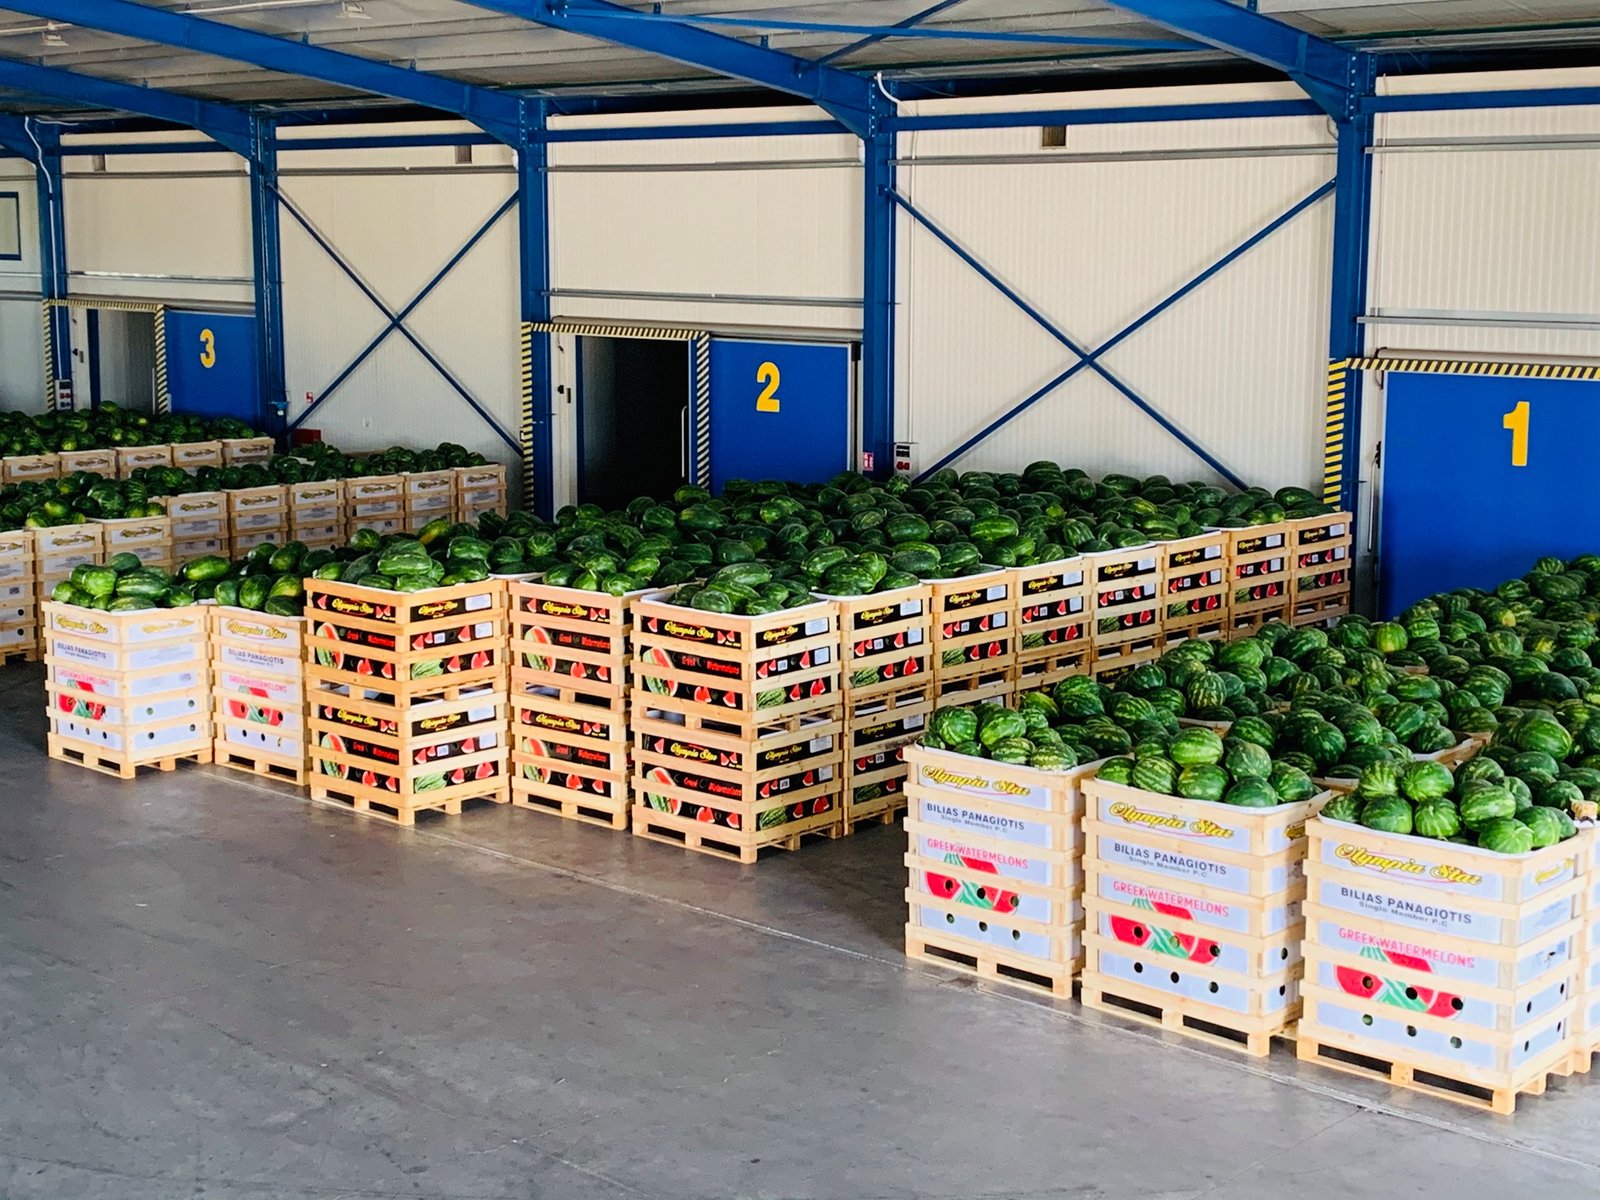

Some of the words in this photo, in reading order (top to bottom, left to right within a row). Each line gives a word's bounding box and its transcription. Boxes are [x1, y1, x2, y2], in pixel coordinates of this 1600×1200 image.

[200, 328, 216, 369] 3
[756, 361, 780, 413] 2
[1503, 401, 1530, 467] 1
[992, 780, 1031, 797] Star
[927, 803, 958, 817] BILIAS
[962, 810, 1025, 831] PANAGIOTIS
[1189, 818, 1234, 839] Star
[1114, 843, 1150, 859] BILIAS
[1154, 851, 1227, 875] PANAGIOTIS
[1430, 864, 1483, 886] Star
[1341, 887, 1382, 905] BILIAS
[1388, 898, 1472, 924] PANAGIOTIS
